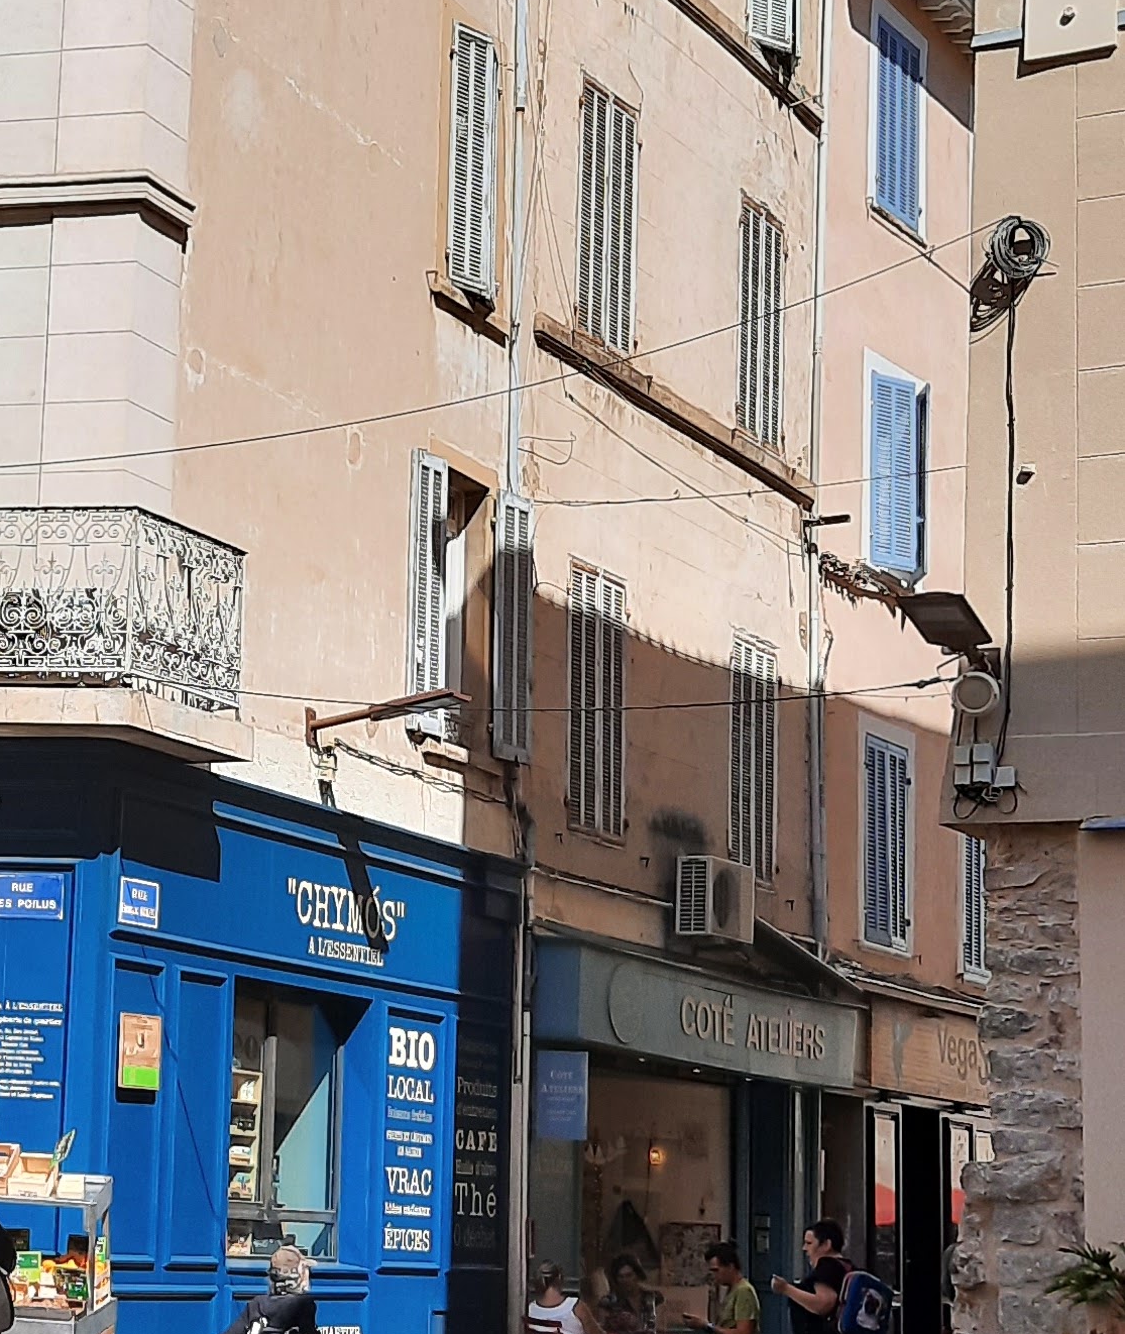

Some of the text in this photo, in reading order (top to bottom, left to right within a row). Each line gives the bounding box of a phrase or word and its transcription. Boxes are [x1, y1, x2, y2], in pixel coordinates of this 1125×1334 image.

[11, 882, 34, 893] RUE
[17, 899, 57, 910] POILUS
[318, 937, 384, 967] L'ESSENTIEL
[388, 1026, 435, 1071] BIO
[387, 1075, 434, 1103] LOCAL
[455, 1125, 498, 1153] CAFÉ
[385, 1166, 432, 1196] VRAC
[455, 1182, 497, 1218] Thé
[383, 1221, 430, 1251] ÉPICES
